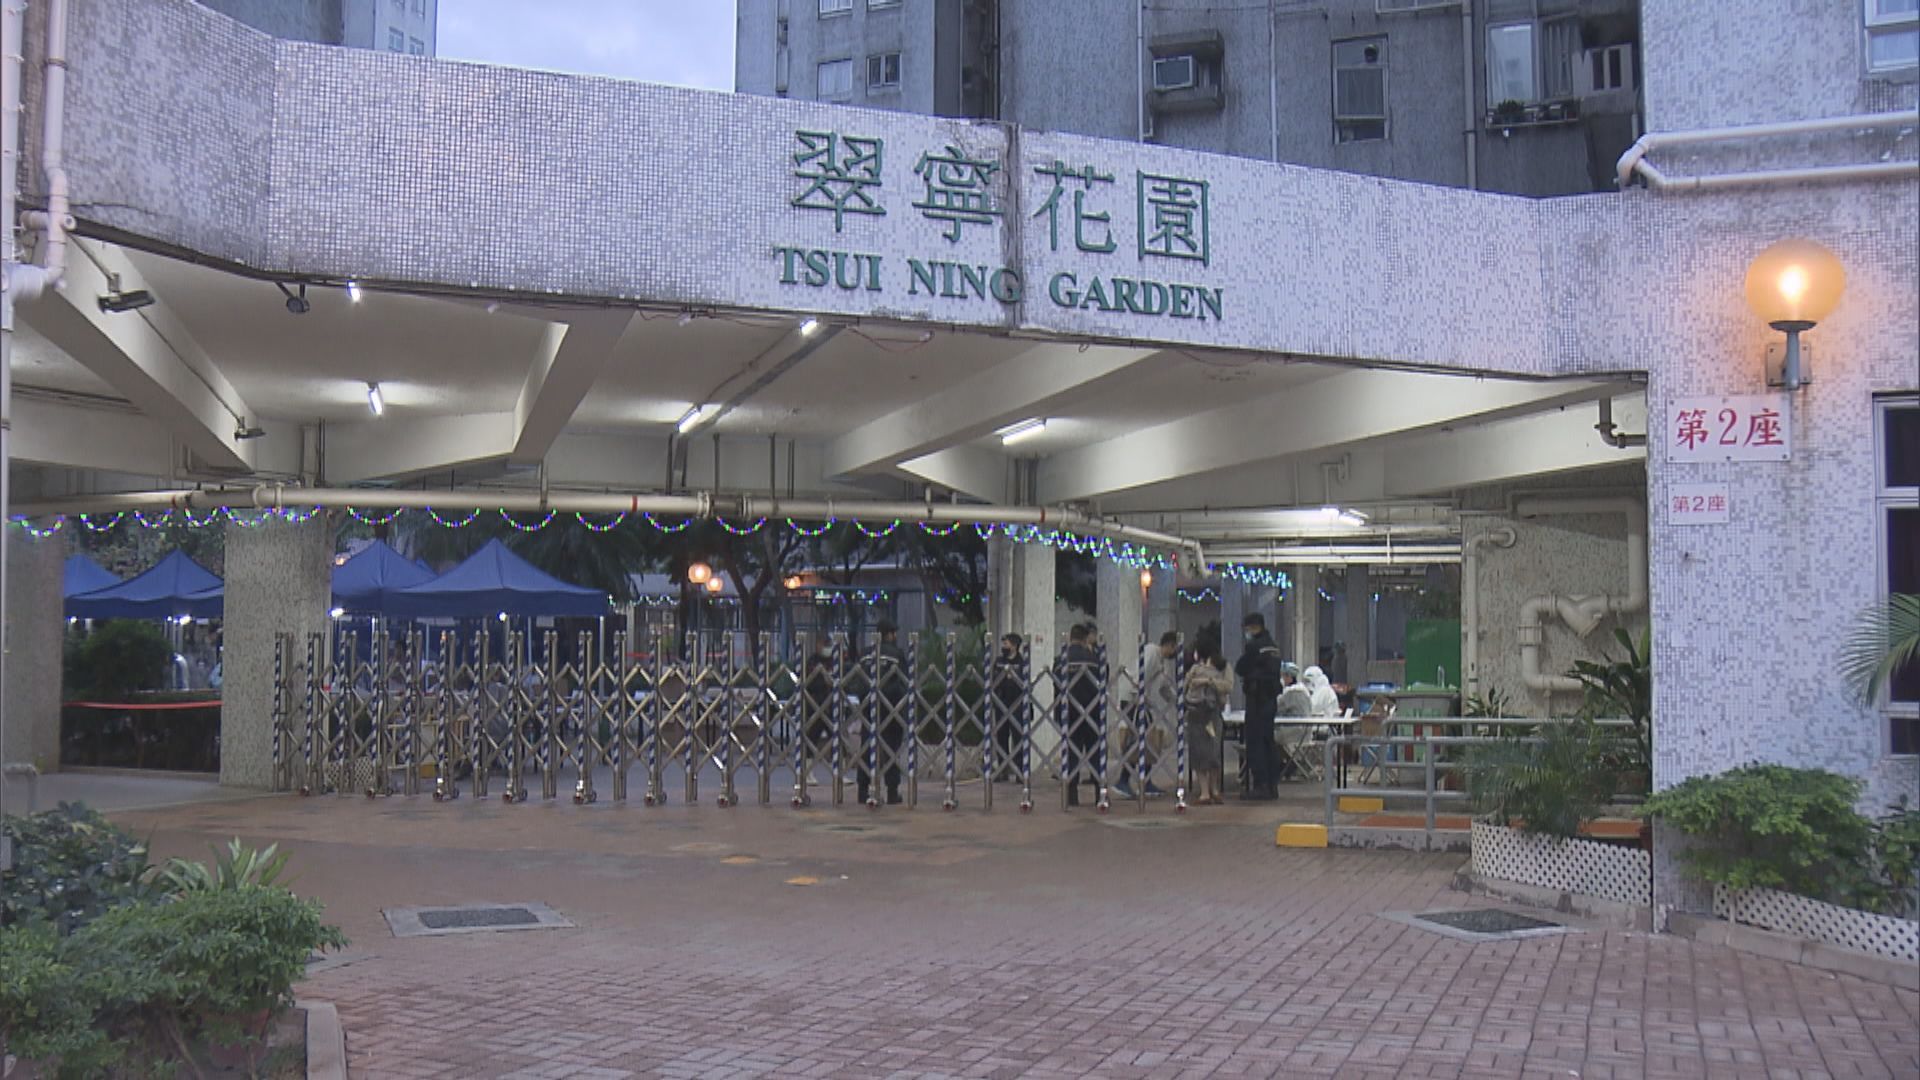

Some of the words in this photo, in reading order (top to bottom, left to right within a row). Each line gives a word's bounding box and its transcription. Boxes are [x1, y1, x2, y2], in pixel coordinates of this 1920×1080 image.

[791, 129, 1211, 267] 翠寧花園
[774, 244, 883, 291] TSUI
[907, 257, 1021, 302] NING
[1048, 271, 1224, 321] GARDEN
[1675, 408, 1784, 450] 第2座
[1672, 494, 1725, 512] 第2座
